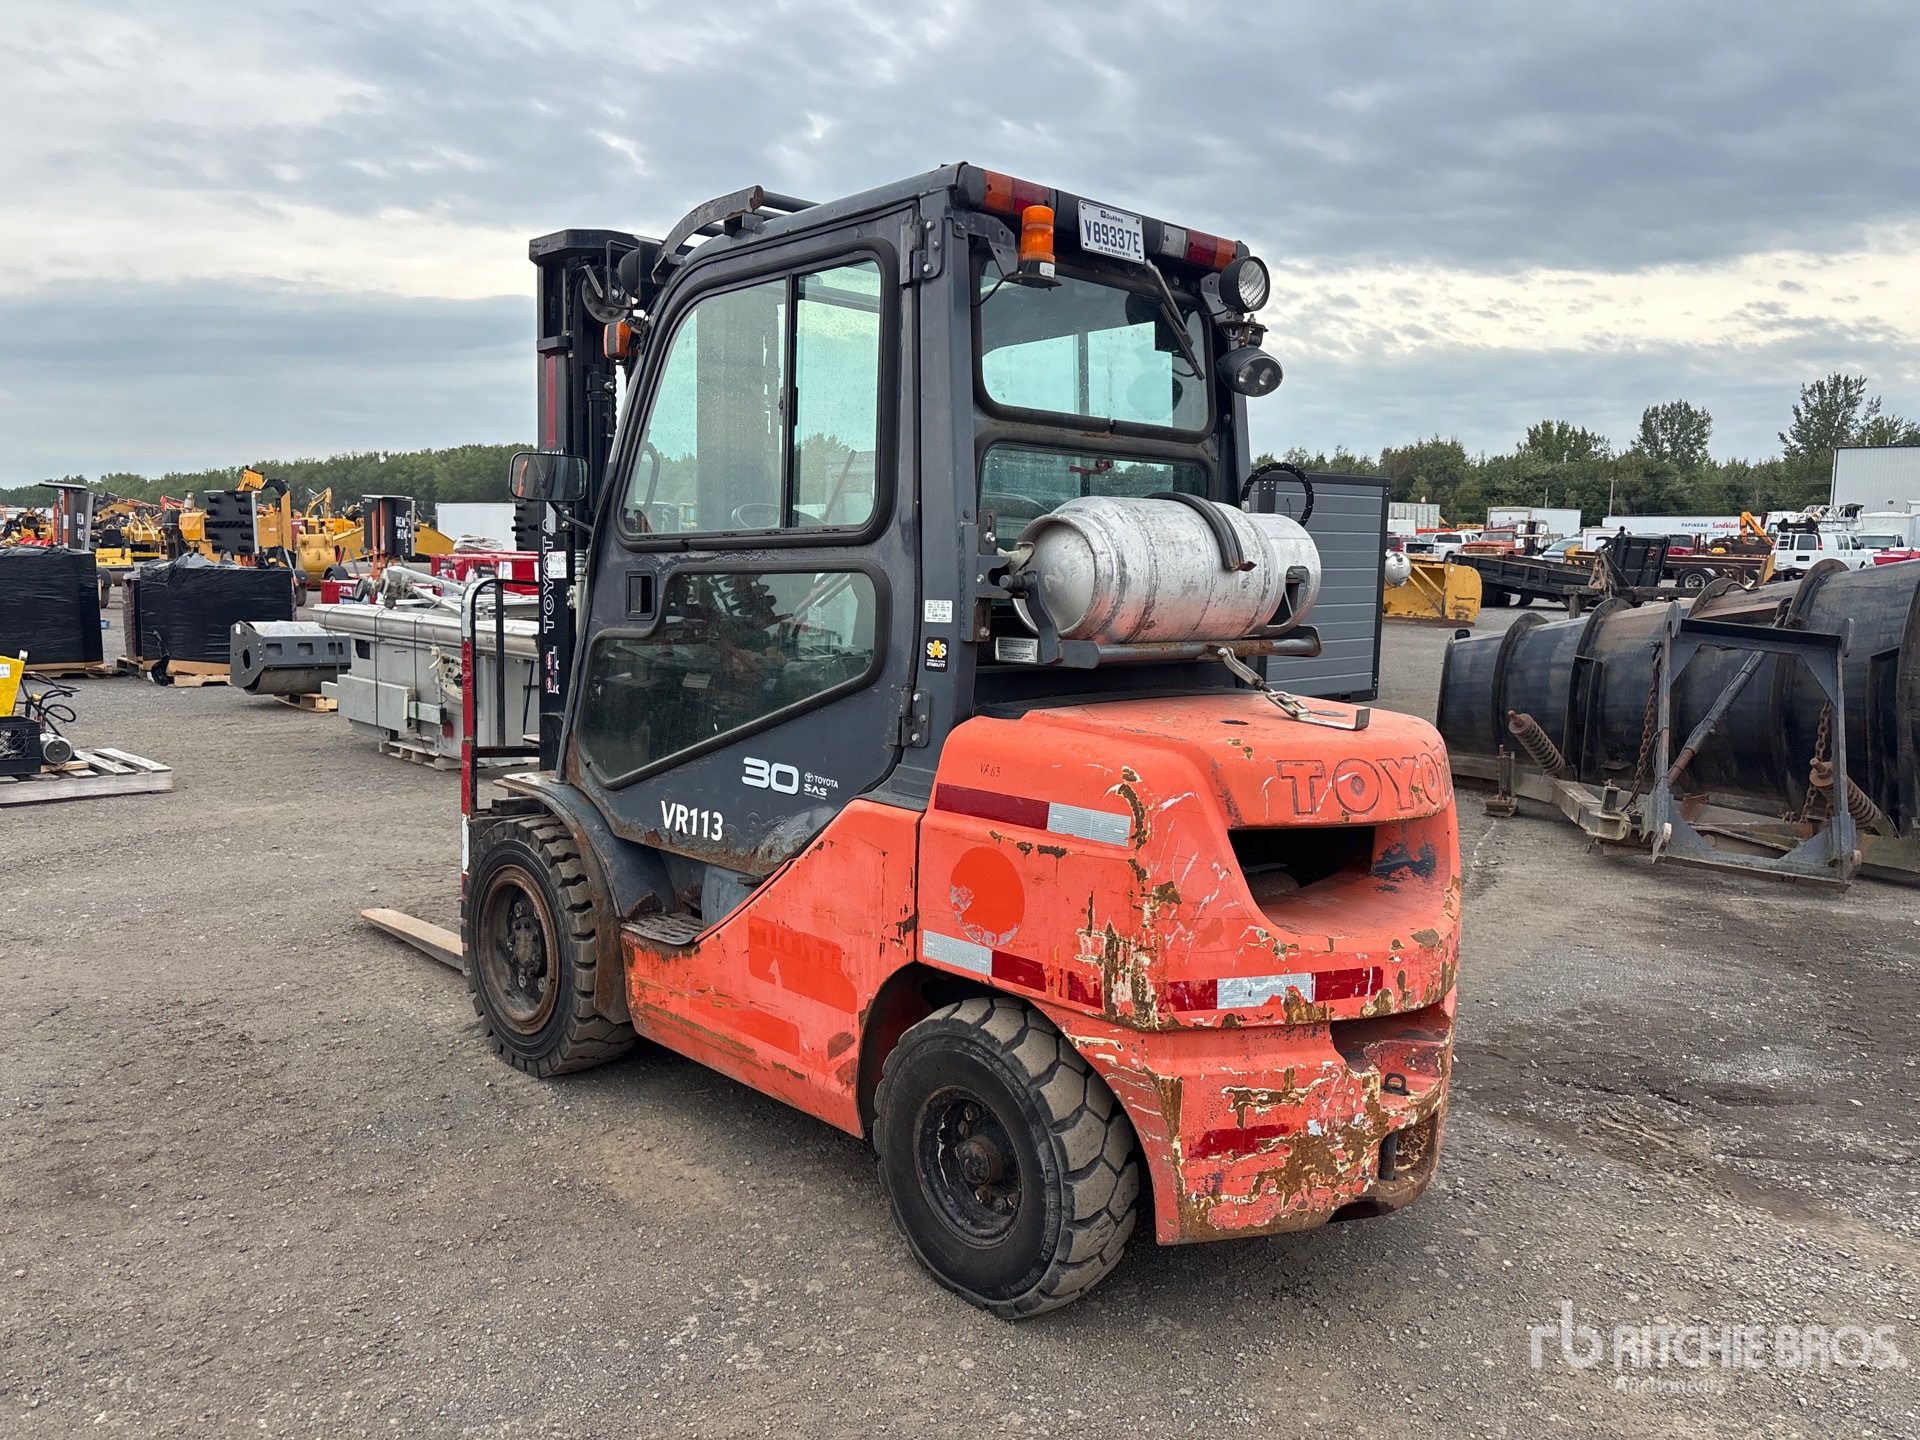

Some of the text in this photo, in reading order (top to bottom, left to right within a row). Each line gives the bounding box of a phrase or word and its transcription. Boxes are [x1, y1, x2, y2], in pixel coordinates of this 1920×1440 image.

[1084, 219, 1141, 254] V89337E
[742, 756, 800, 795] 30
[803, 783, 828, 797] SAS
[814, 775, 839, 789] TOYOTA
[660, 800, 724, 842] VR113
